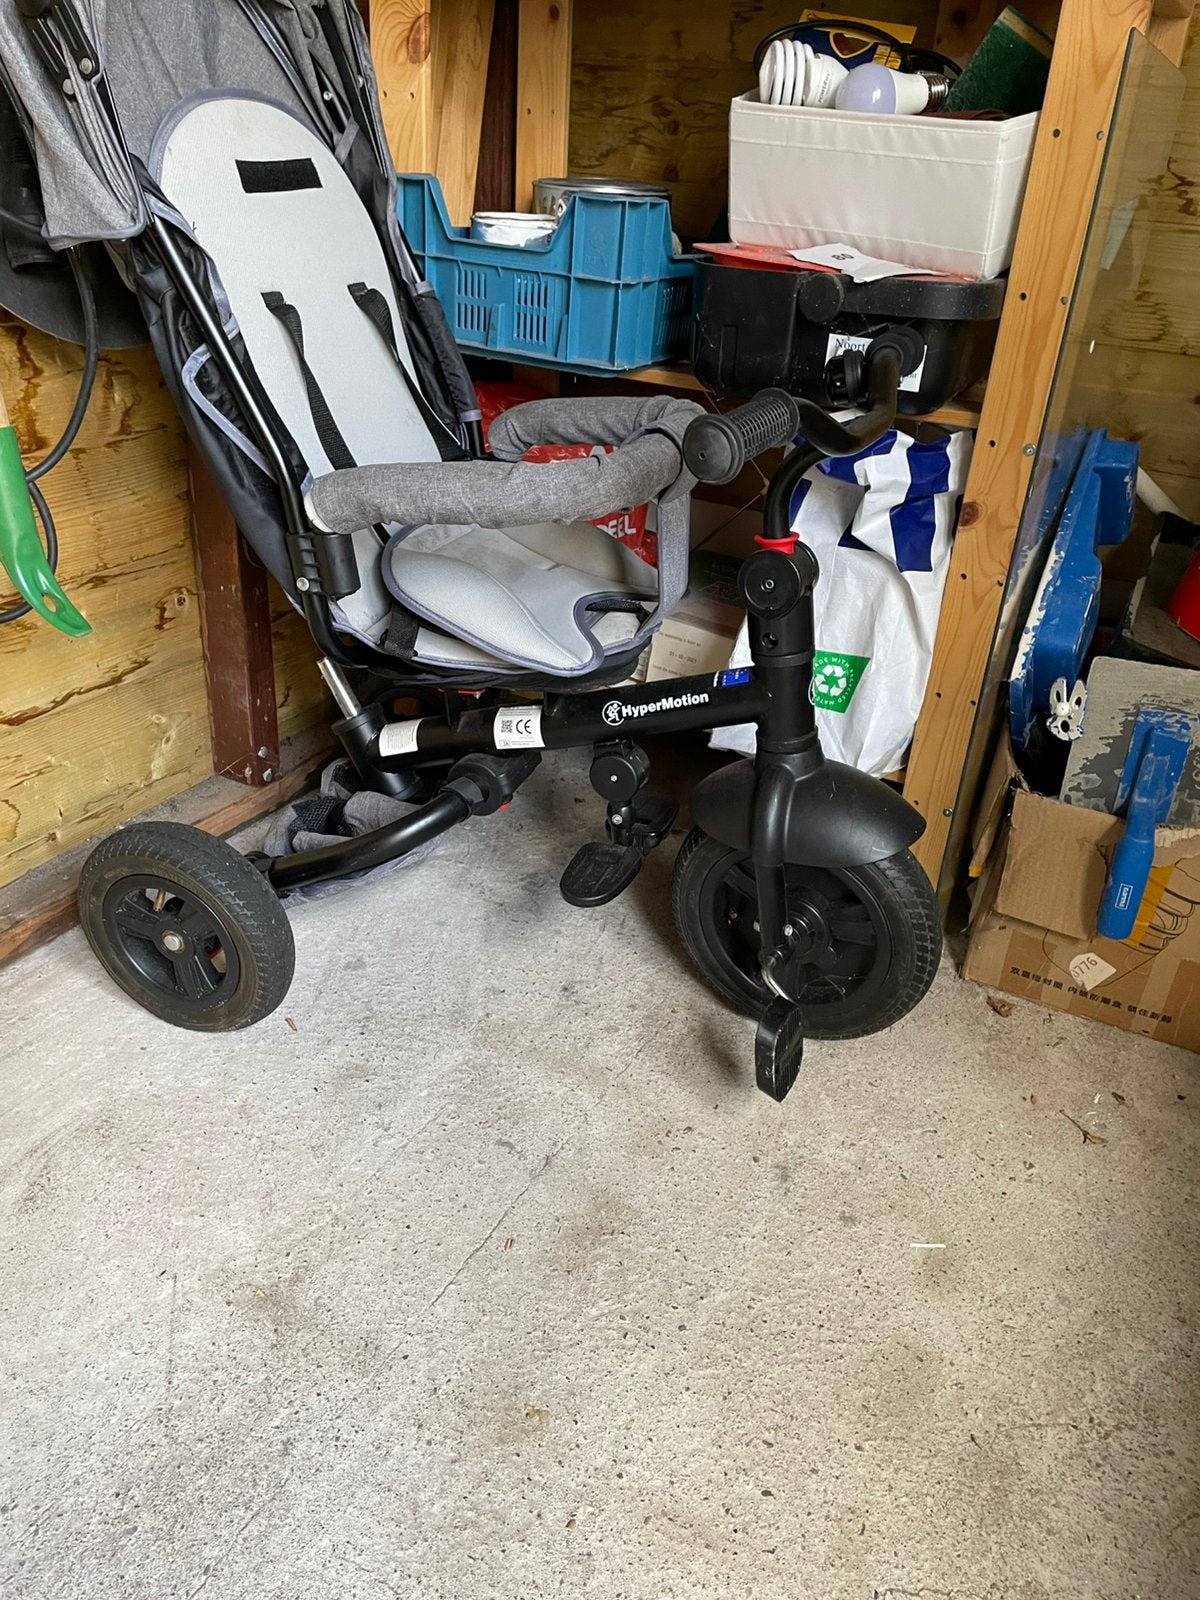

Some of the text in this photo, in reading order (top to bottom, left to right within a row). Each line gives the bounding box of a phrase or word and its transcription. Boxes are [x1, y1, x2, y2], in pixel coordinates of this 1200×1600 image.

[813, 657, 828, 669] ADE
[832, 657, 850, 668] WITH
[621, 692, 709, 718] HyperMotion
[515, 718, 532, 735] CE
